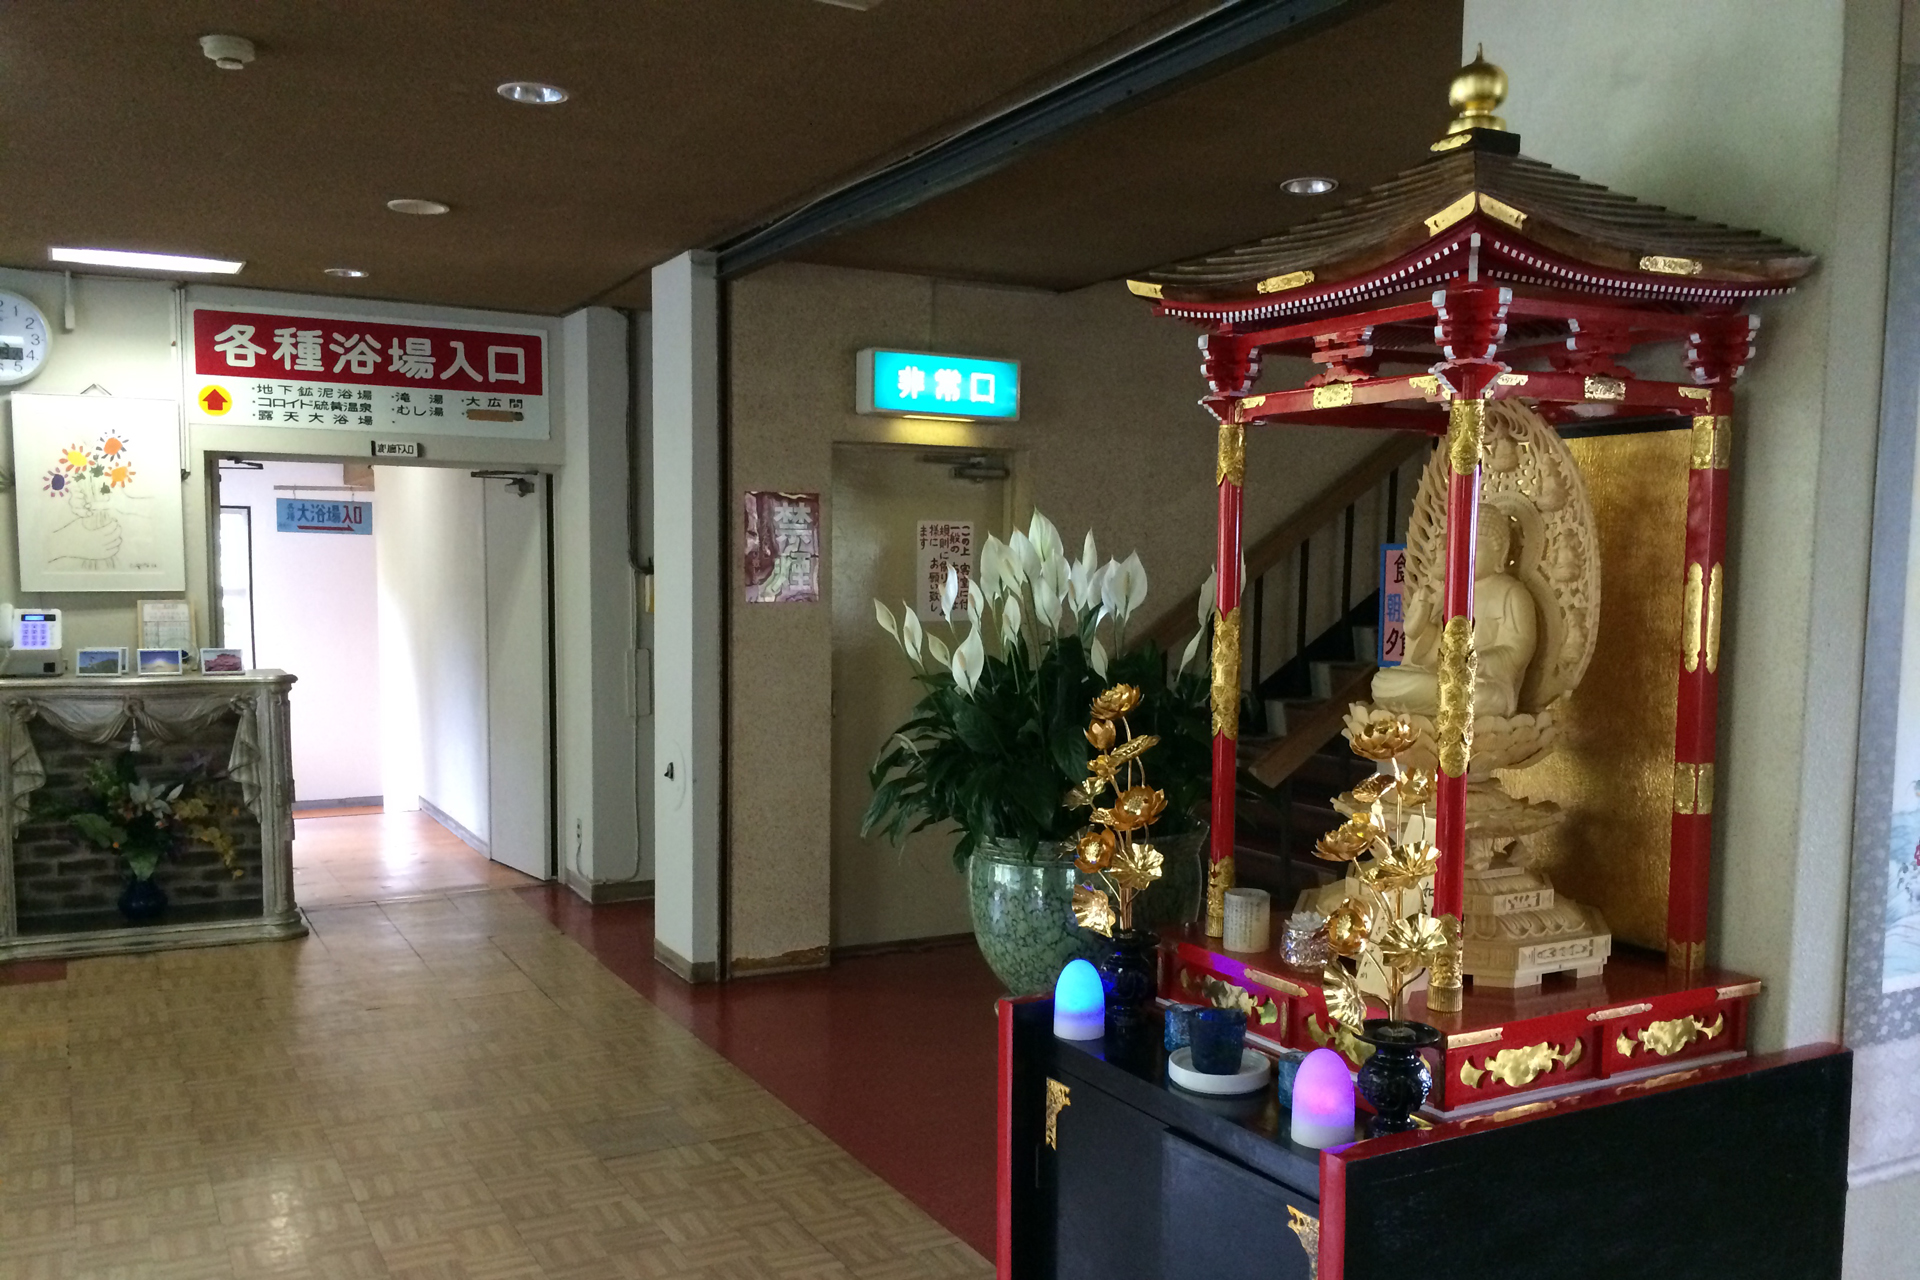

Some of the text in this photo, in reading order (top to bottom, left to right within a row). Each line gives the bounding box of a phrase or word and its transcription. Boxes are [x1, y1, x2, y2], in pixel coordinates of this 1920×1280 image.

[25, 317, 35, 330] 2
[30, 334, 40, 346] 3
[26, 350, 35, 361] 4
[213, 323, 526, 385] 各種浴場入口
[14, 361, 23, 372] 5
[897, 365, 996, 404] 非常口
[766, 501, 812, 593] 禁煙
